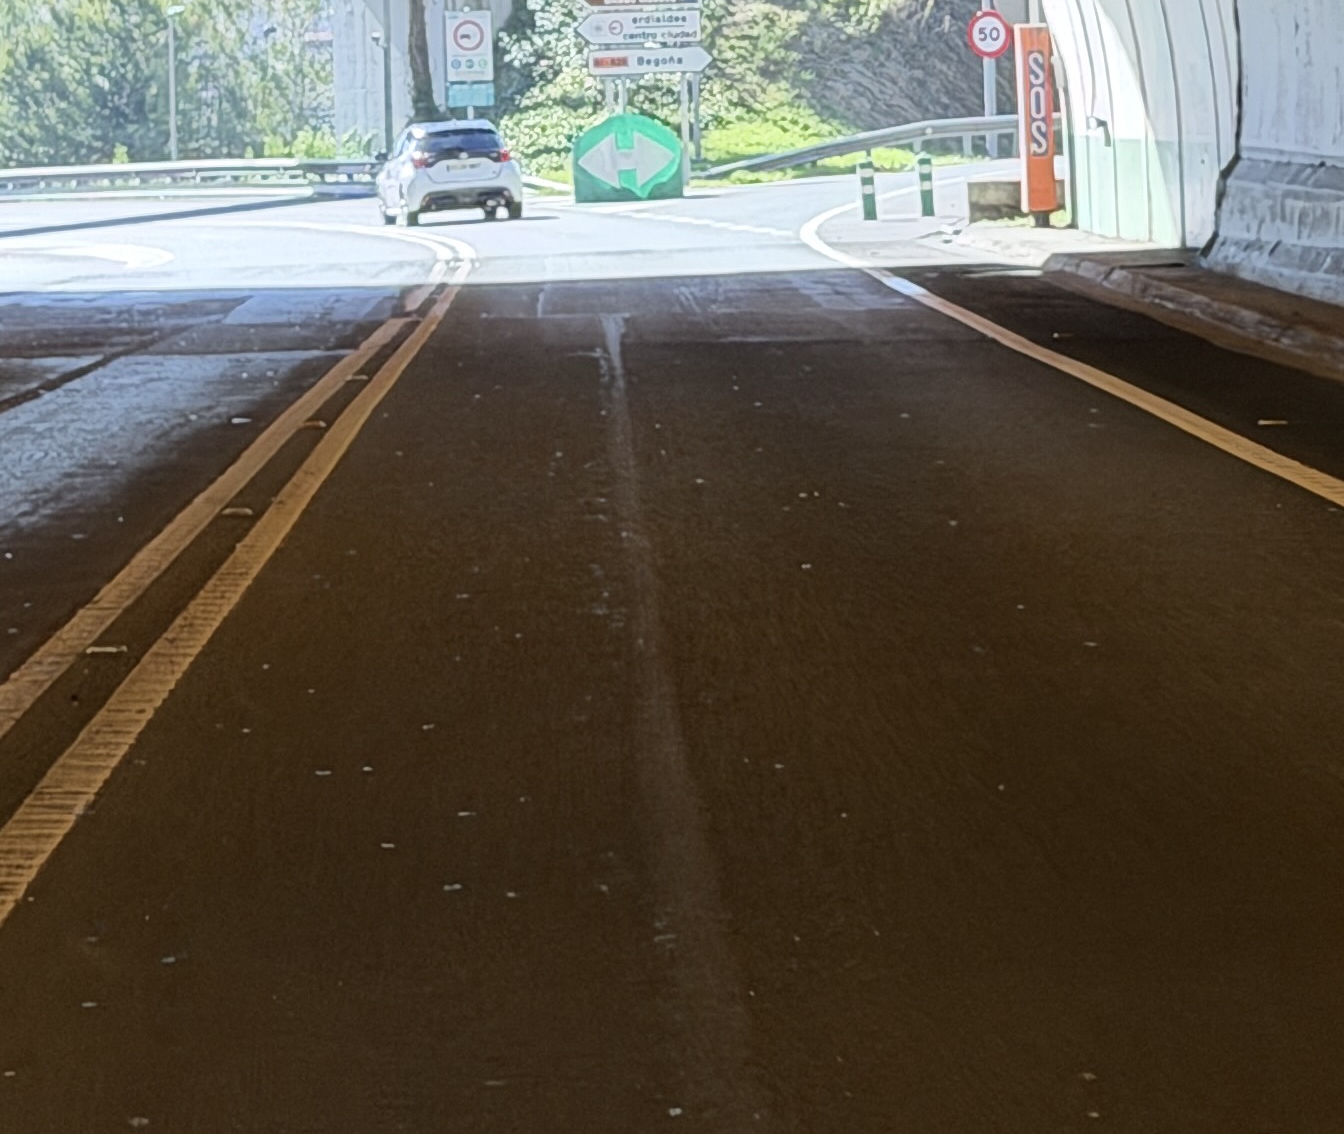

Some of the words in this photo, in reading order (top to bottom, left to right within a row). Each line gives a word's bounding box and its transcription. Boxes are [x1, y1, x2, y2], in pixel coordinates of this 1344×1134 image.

[622, 31, 658, 41] centro
[978, 26, 1001, 42] 50
[637, 56, 683, 67] Begoña
[1028, 51, 1047, 154] SOS
